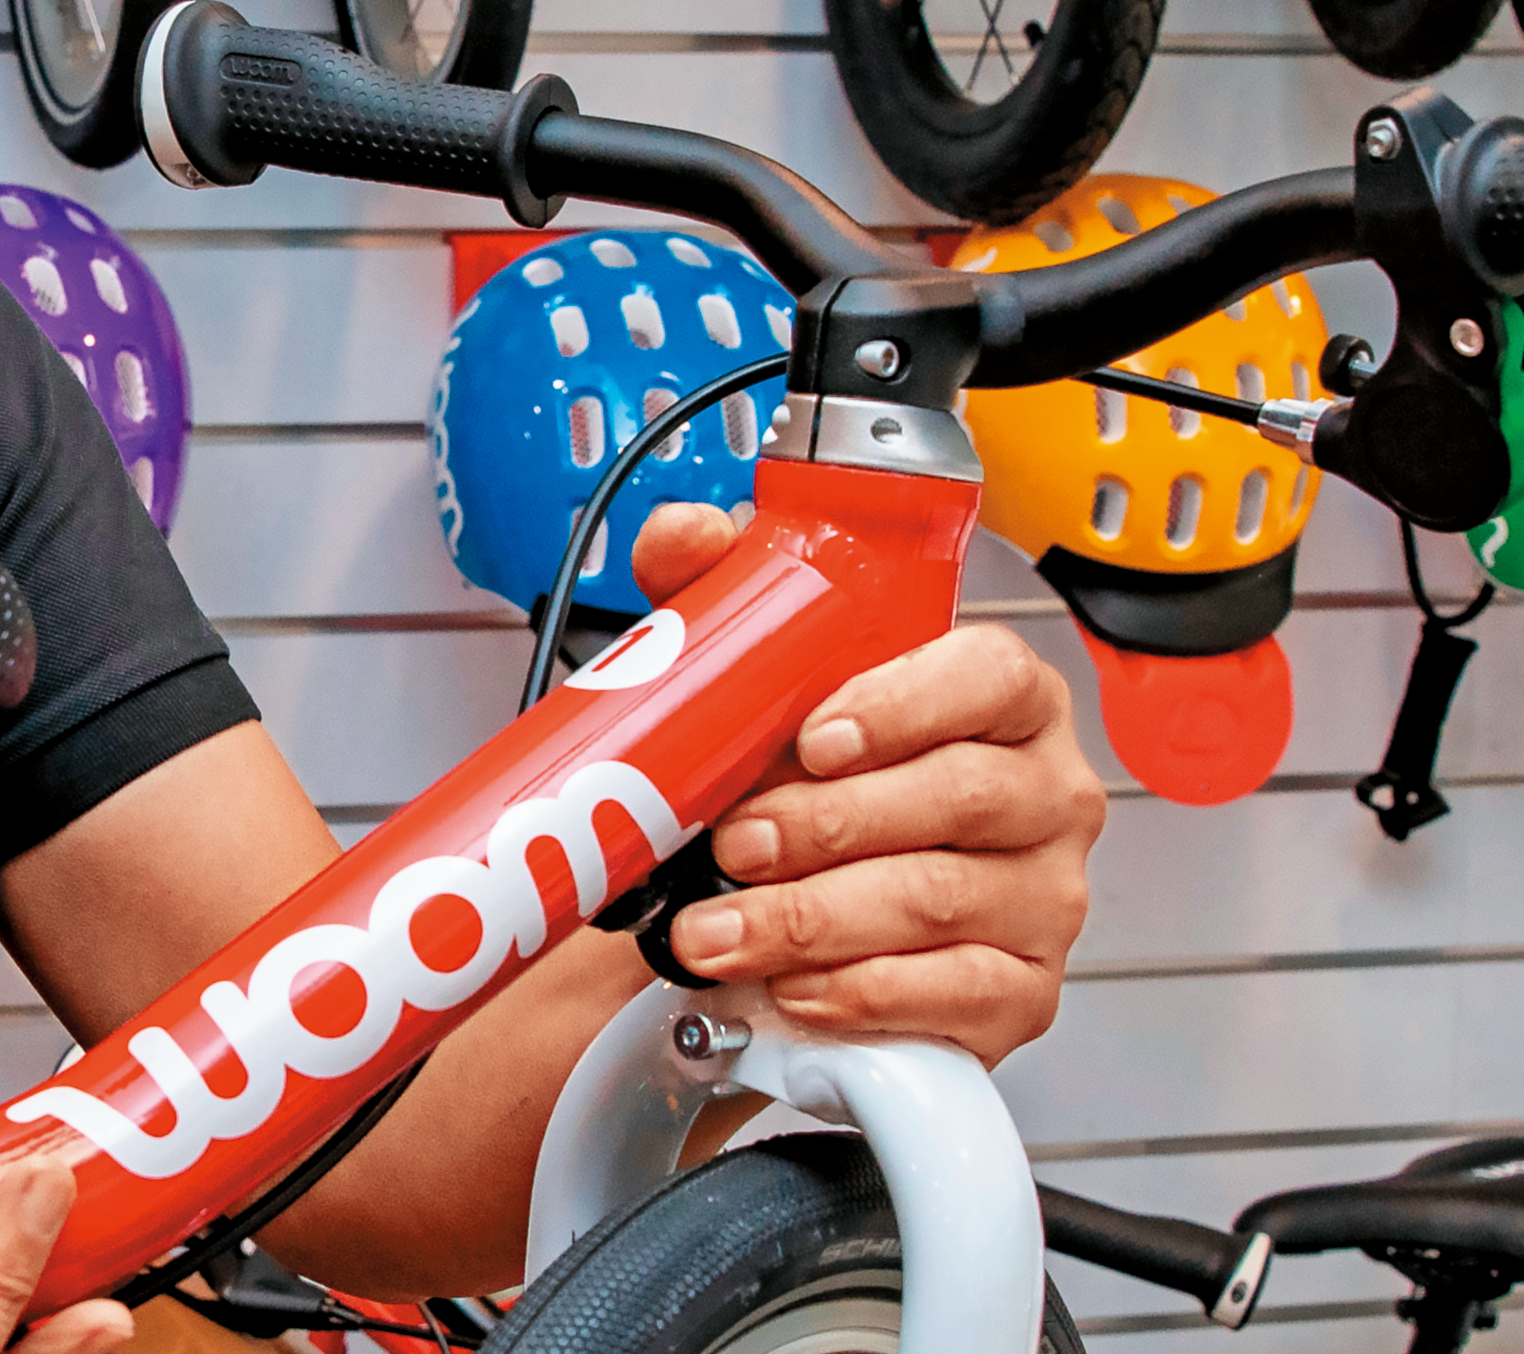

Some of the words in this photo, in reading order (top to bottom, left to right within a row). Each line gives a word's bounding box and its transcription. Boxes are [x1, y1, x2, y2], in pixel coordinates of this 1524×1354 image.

[228, 58, 294, 80] woom
[591, 624, 654, 674] 1
[6, 760, 710, 1180] woom
